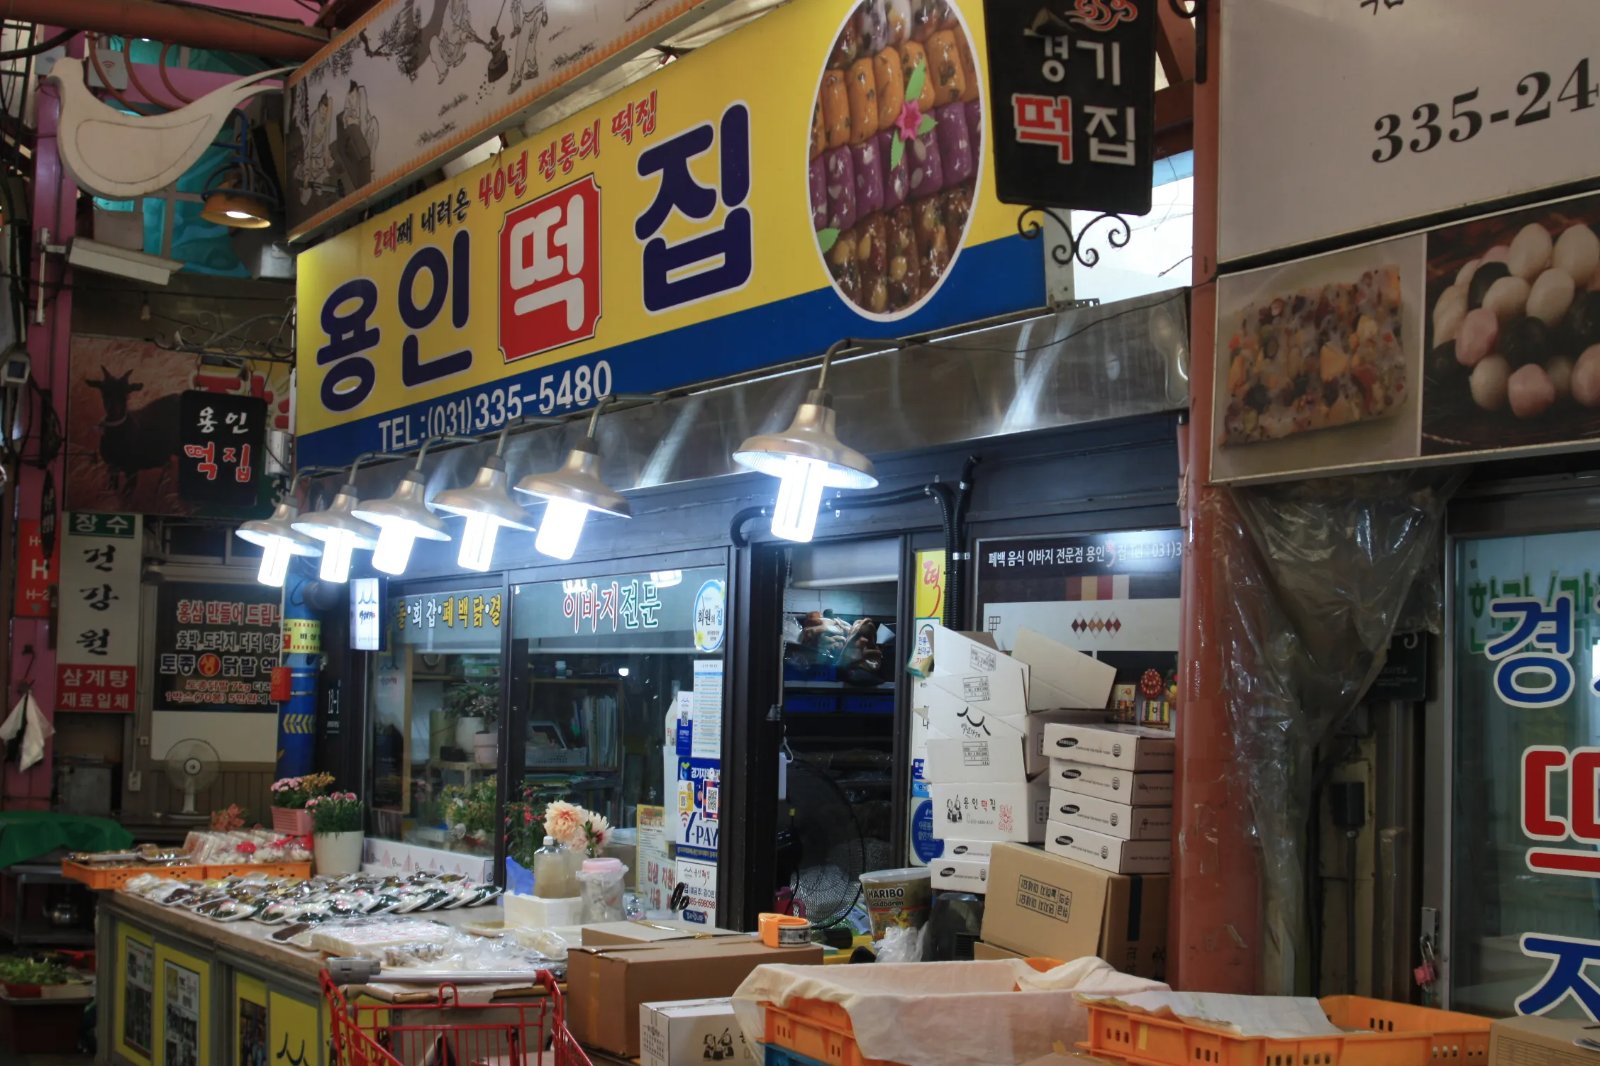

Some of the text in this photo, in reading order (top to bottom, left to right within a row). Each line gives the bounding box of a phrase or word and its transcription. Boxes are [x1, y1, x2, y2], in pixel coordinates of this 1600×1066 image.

[1012, 93, 1136, 167] 떡집
[373, 89, 659, 257] 2대째 내려온 40년 전통의 떡집
[197, 406, 249, 434] 용인
[75, 514, 129, 535] 장수
[988, 551, 1006, 568] 폐백
[1007, 549, 1025, 567] 음식
[1027, 547, 1054, 566] 이바지
[1056, 547, 1084, 564] 전문점
[206, 601, 244, 626] 만들어
[62, 668, 129, 688] 삼계탕
[61, 692, 129, 710] 재료일체
[867, 888, 904, 899] HARIBO
